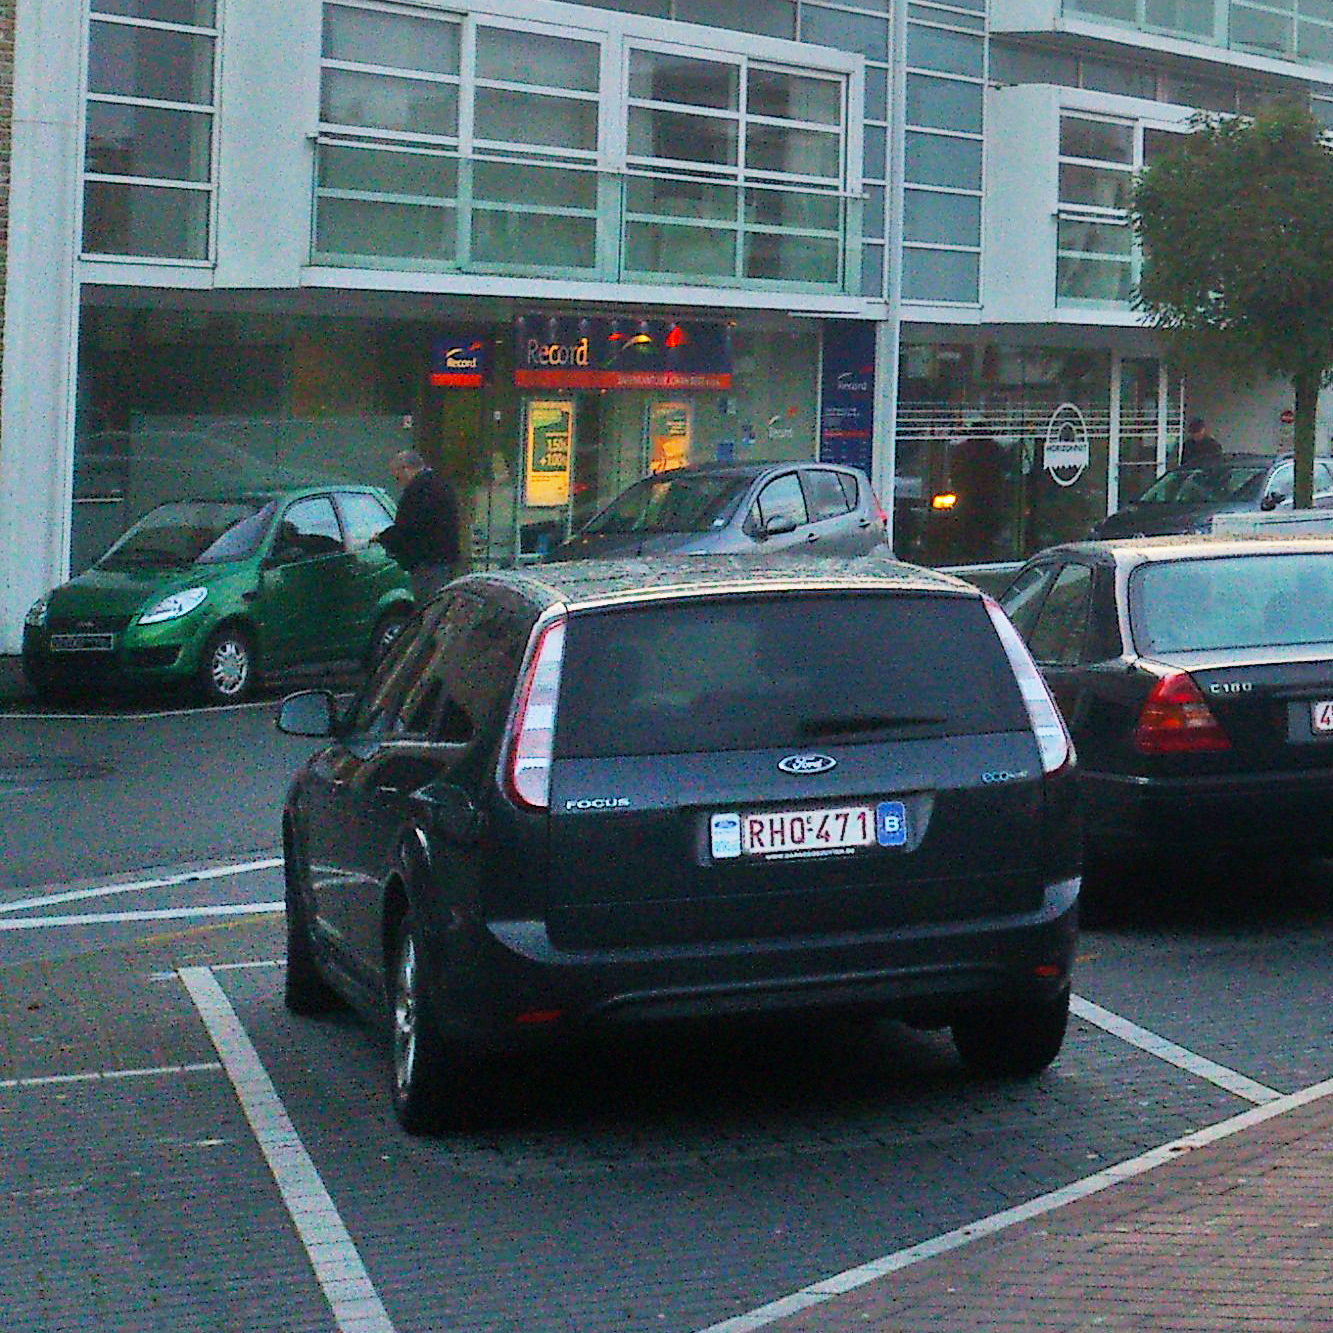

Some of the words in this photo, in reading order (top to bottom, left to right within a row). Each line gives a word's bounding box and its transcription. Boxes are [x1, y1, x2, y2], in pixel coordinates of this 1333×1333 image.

[527, 337, 589, 367] Record
[446, 356, 477, 368] Record
[793, 755, 827, 772] Ford
[565, 797, 630, 810] FOCUS
[884, 816, 899, 833] B
